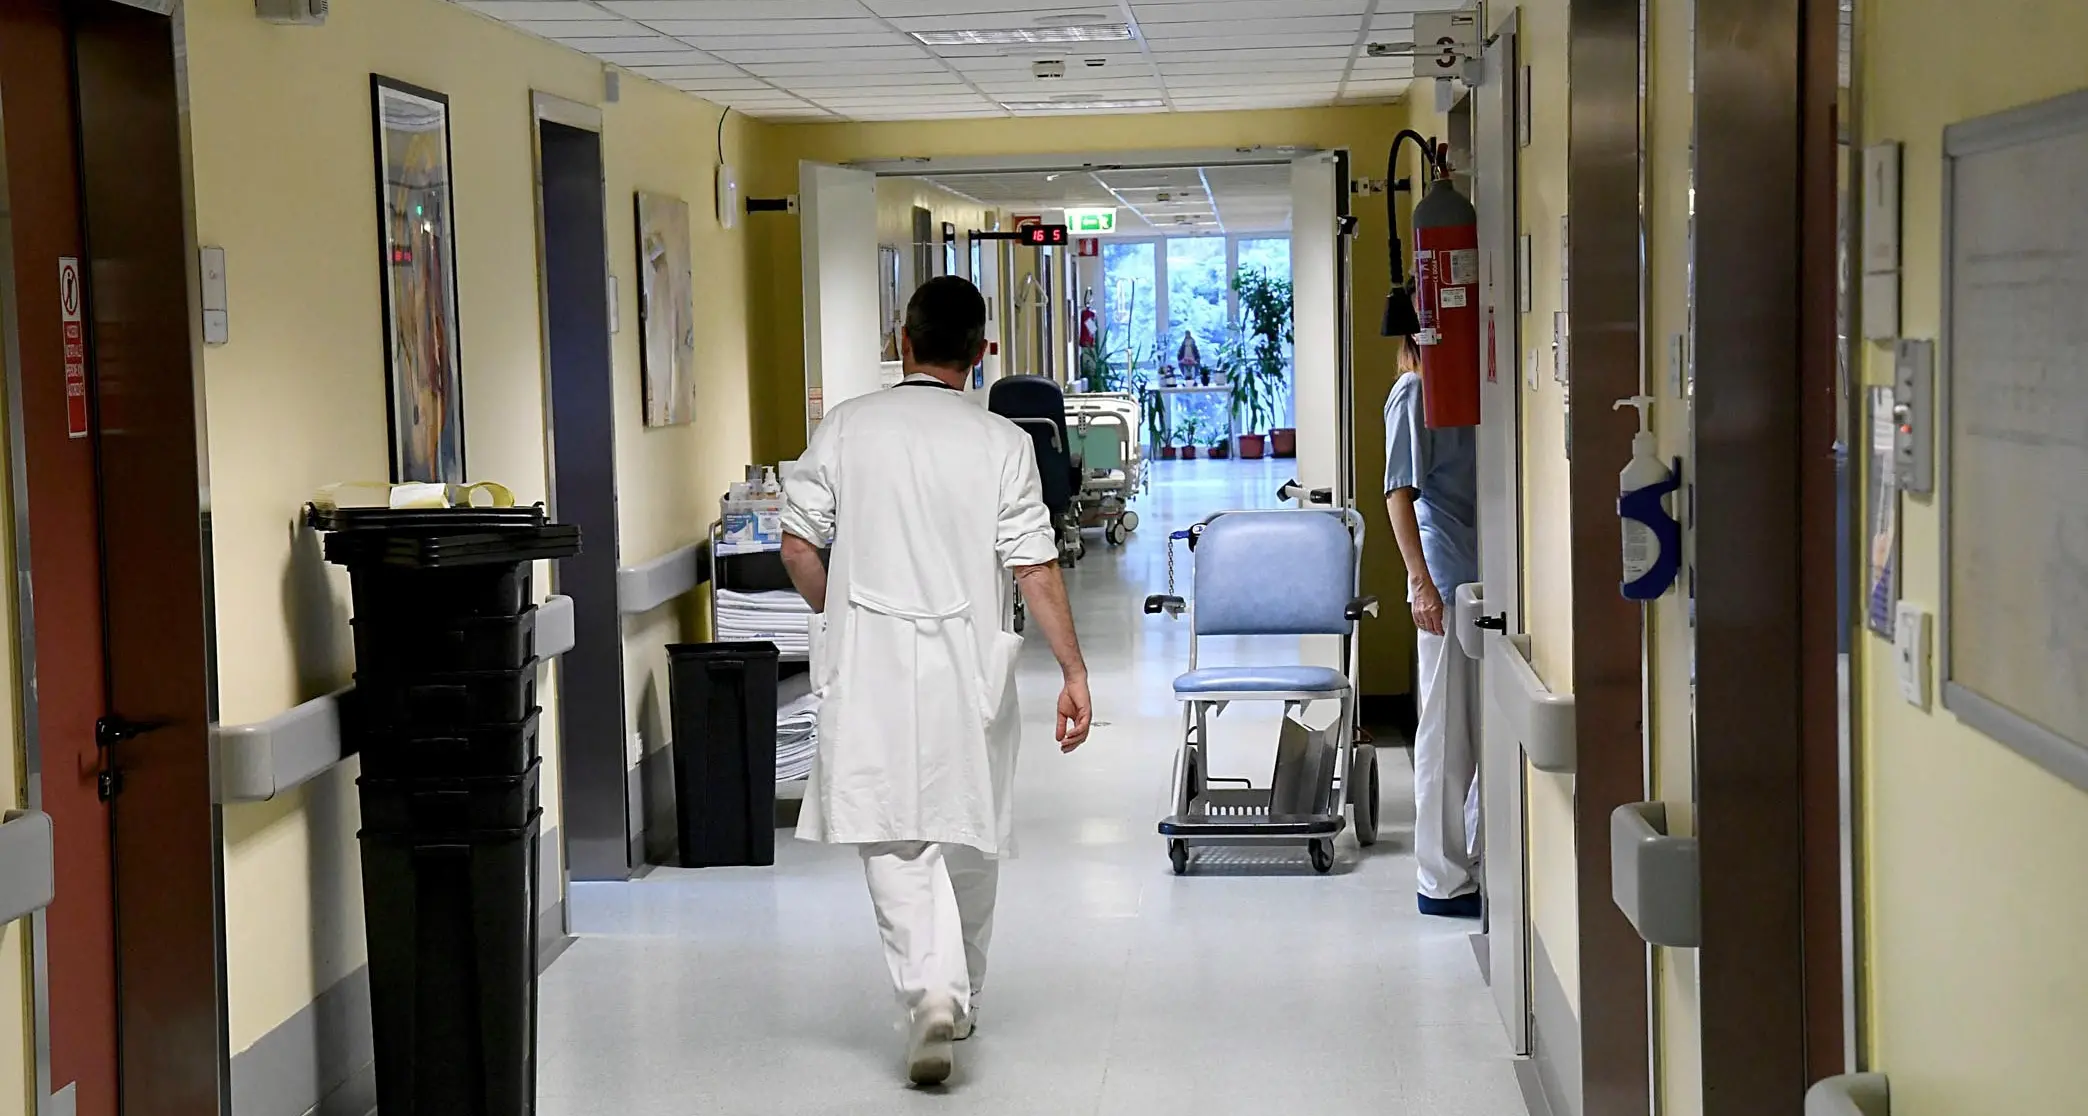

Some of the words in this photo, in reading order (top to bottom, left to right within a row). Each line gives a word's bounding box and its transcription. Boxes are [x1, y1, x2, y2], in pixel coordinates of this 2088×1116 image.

[1436, 37, 1456, 68] 3
[1032, 230, 1044, 241] 16
[1053, 229, 1061, 241] 5
